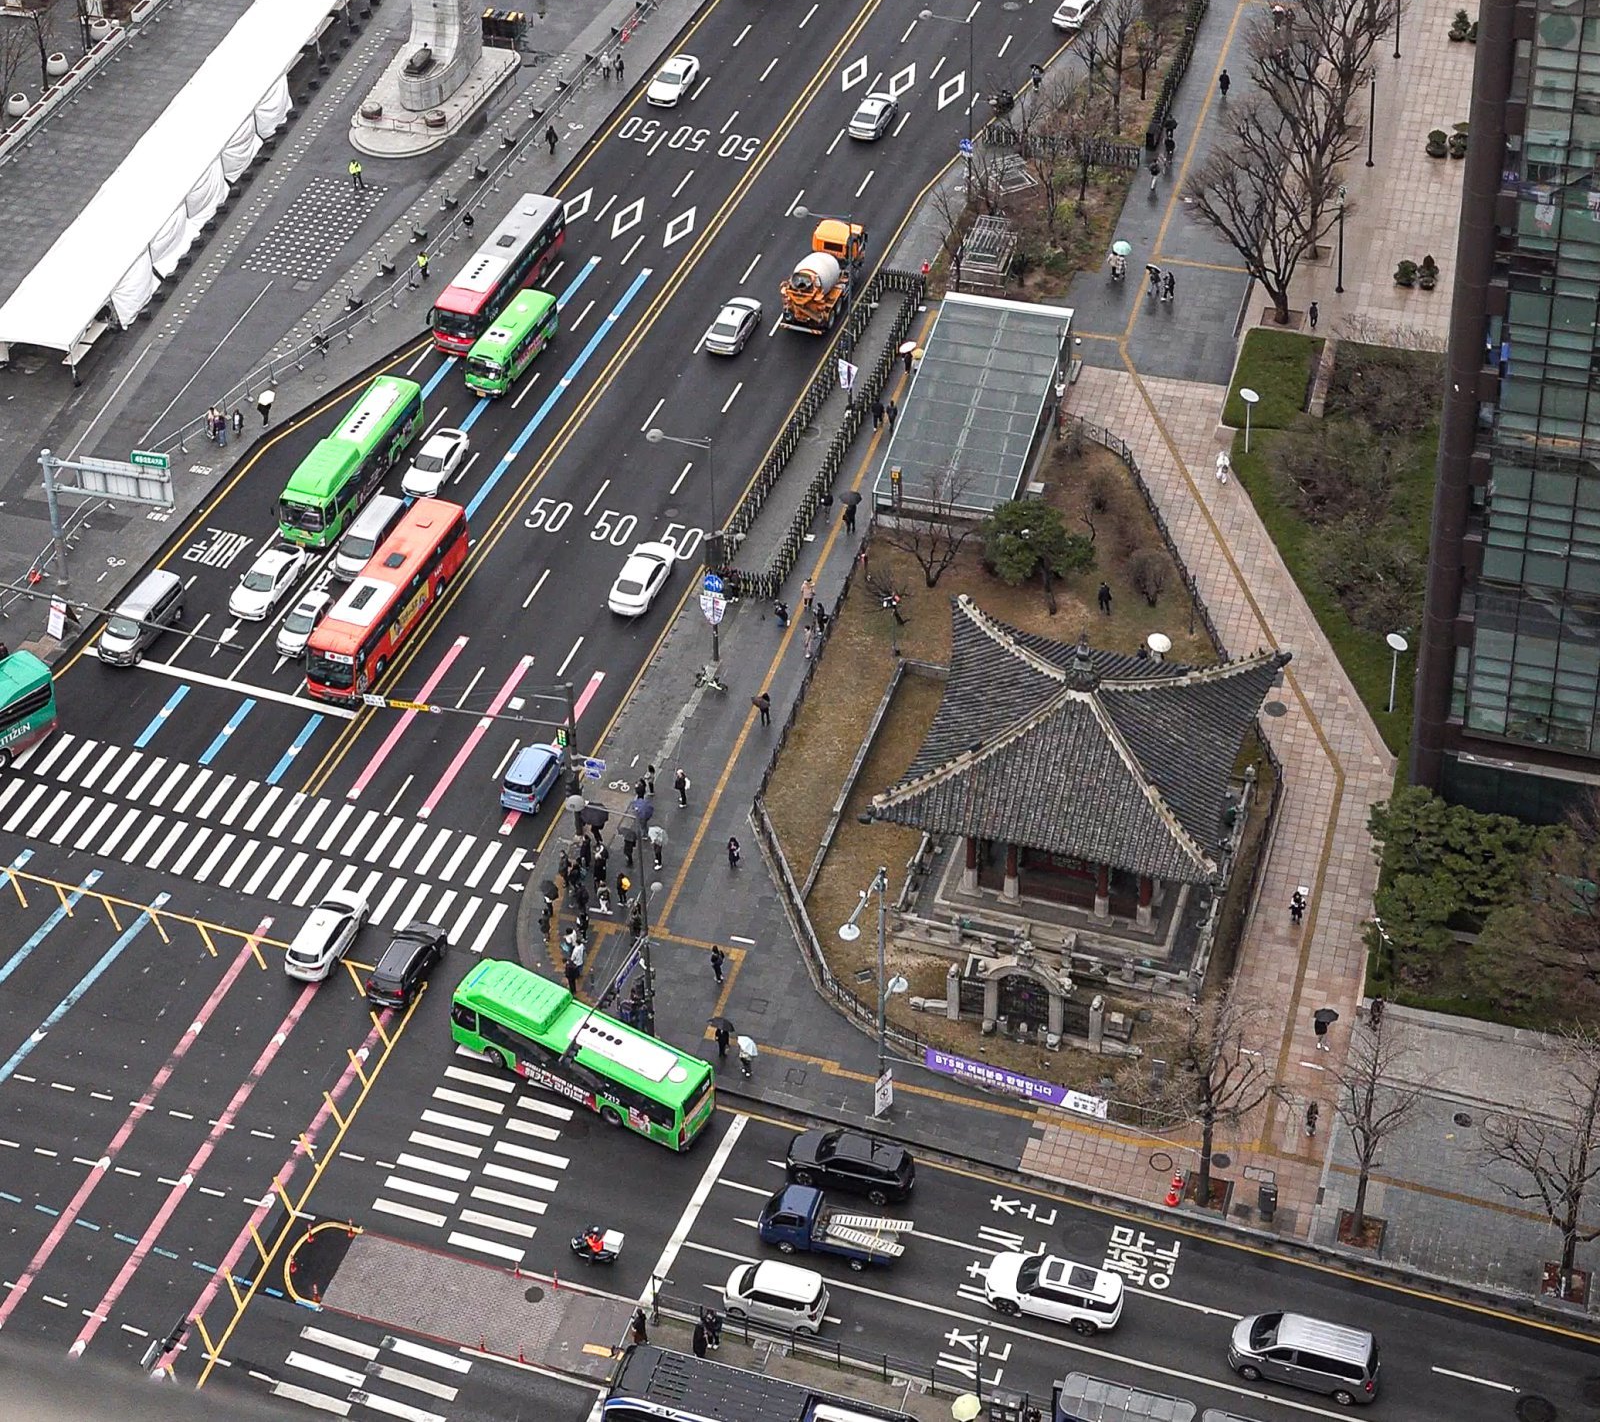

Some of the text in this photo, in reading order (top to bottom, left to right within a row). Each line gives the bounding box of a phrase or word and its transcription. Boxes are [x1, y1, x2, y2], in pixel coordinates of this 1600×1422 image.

[618, 116, 661, 143] 50
[667, 125, 711, 152] 50
[717, 134, 761, 161] 50
[524, 497, 574, 533] 50
[590, 509, 638, 546] 50
[182, 527, 253, 569] 서대문
[660, 523, 704, 560] 50
[0, 721, 31, 746] ITIZEN
